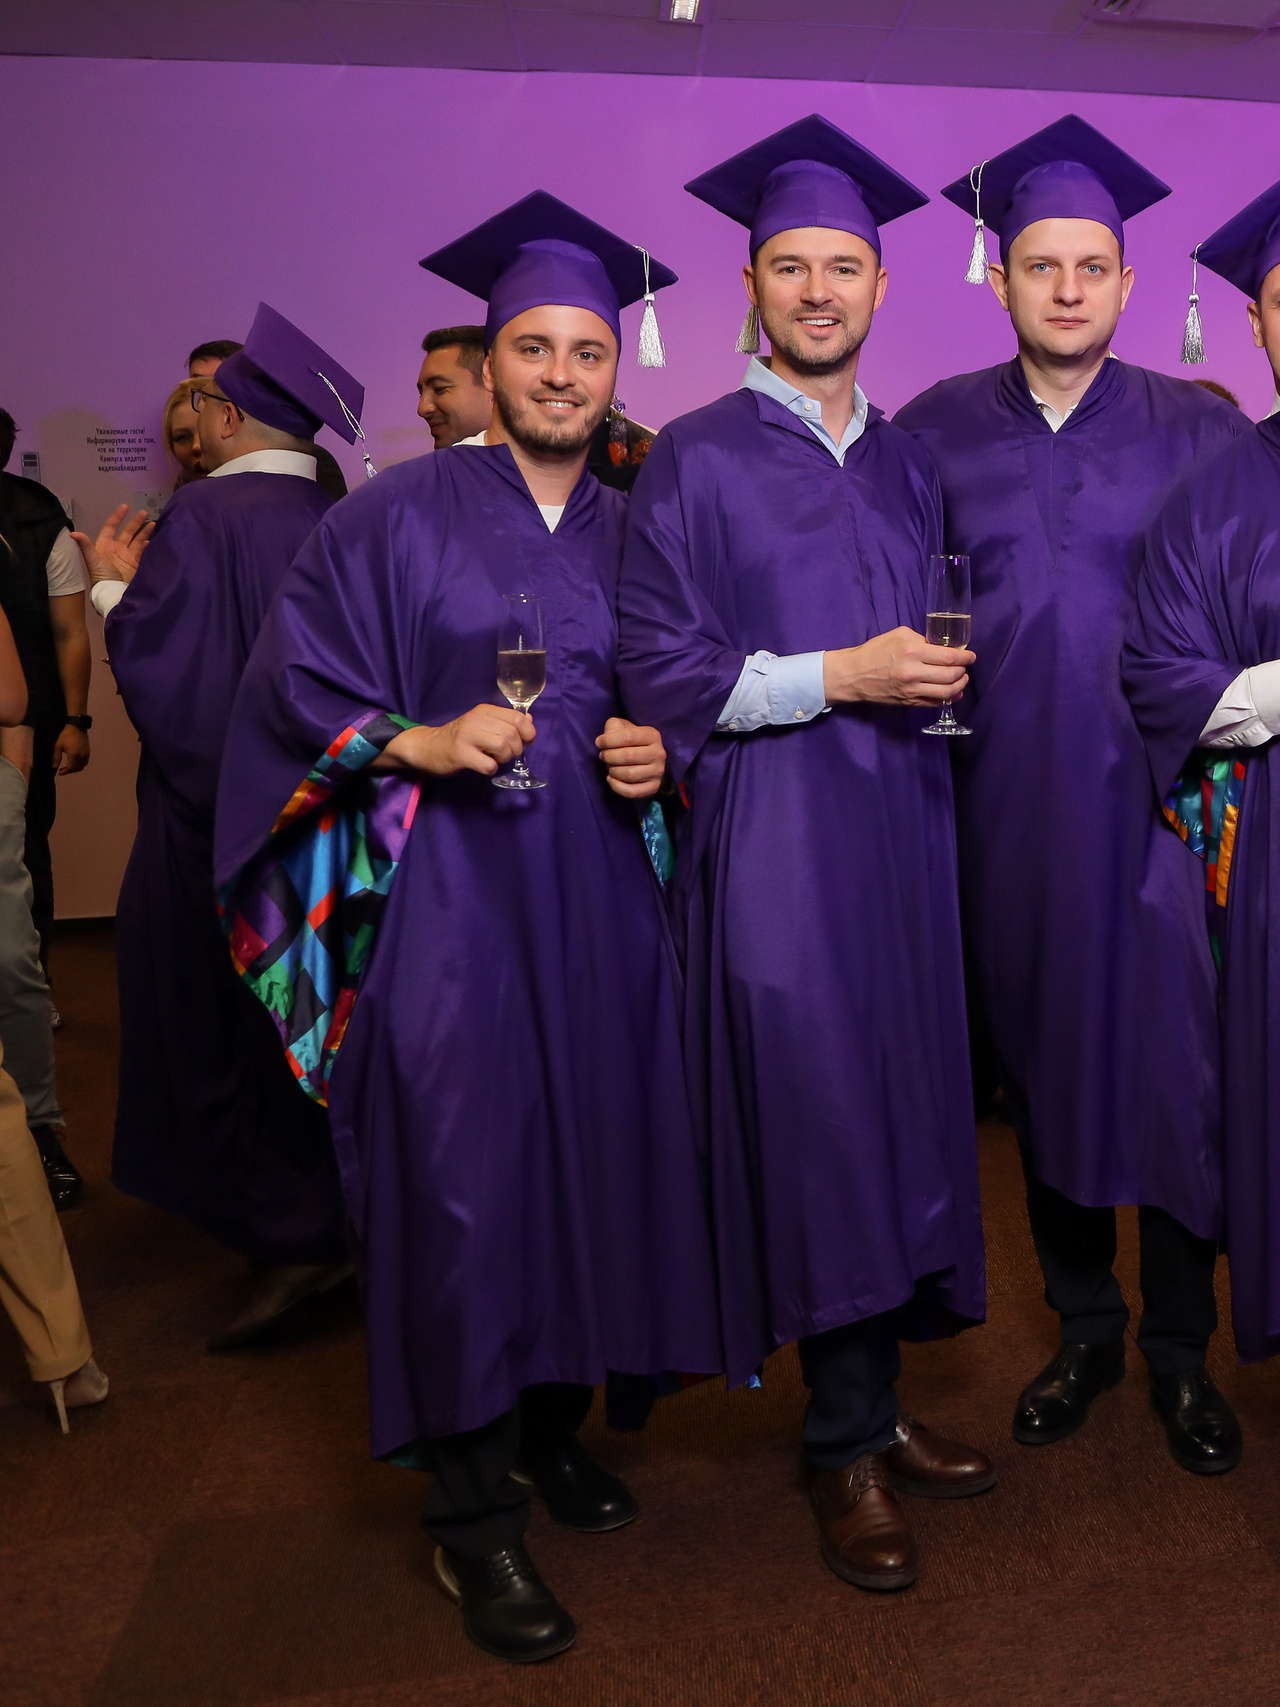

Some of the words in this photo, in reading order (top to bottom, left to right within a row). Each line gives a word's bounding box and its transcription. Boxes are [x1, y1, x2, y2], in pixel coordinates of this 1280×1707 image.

[96, 427, 128, 435] Уважаемые
[130, 427, 146, 435] гости!
[86, 437, 126, 446] Информируем
[100, 455, 123, 464] Кампуса
